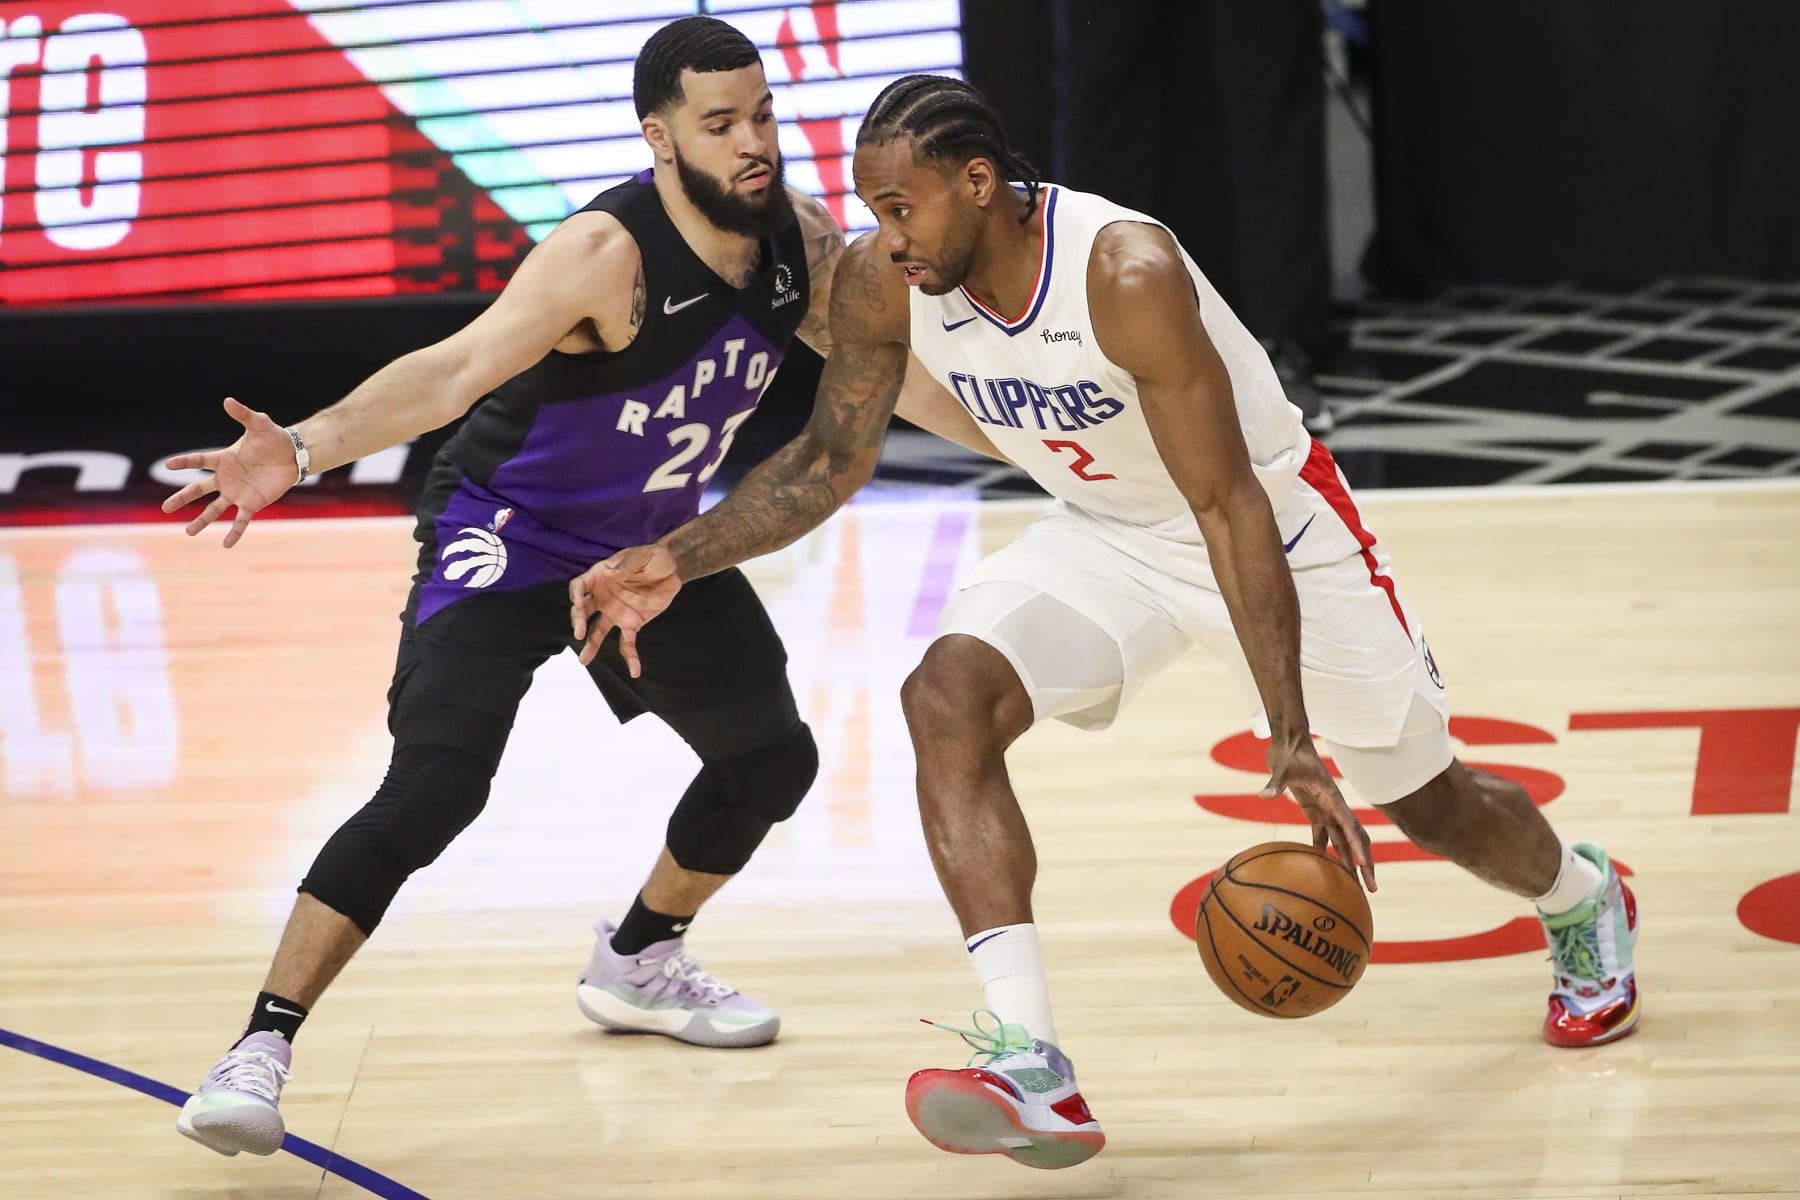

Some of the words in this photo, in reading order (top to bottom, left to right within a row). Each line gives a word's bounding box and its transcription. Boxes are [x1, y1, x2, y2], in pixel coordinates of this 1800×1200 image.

[771, 298, 785, 309] Sun
[784, 289, 800, 303] Life
[1040, 328, 1083, 347] honey
[949, 371, 1125, 432] CLIPPERS
[642, 408, 757, 493] 23
[1041, 439, 1118, 482] 2
[1253, 903, 1360, 982] SPALDING
